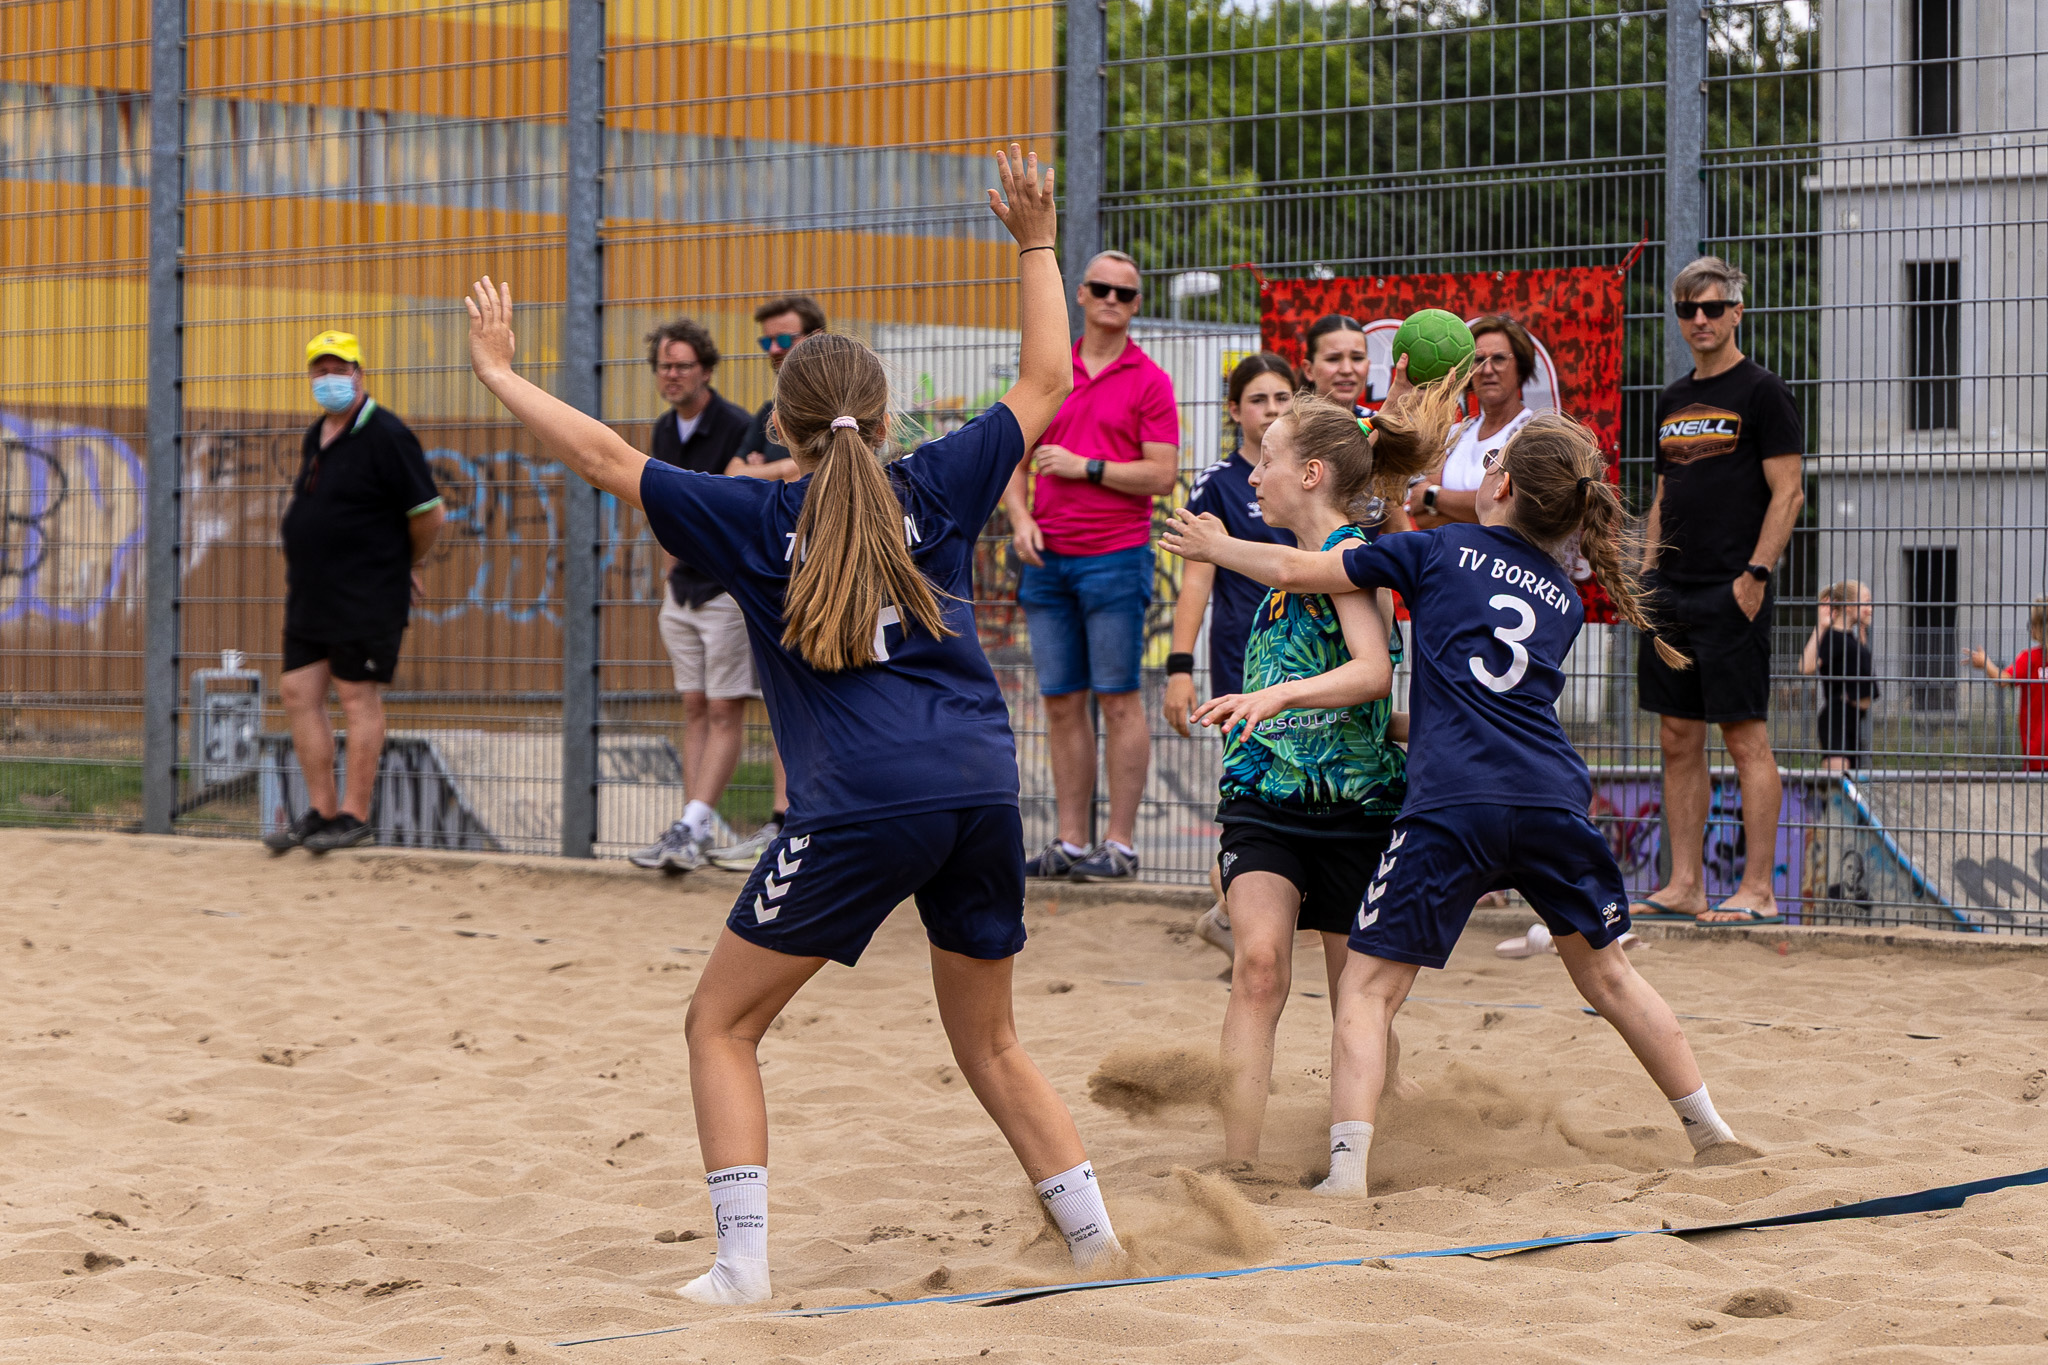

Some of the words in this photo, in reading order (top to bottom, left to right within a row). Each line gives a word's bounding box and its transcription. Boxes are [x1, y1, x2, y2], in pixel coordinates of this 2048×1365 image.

[1458, 546, 1487, 571] TV
[1491, 558, 1570, 615] BORKEN
[1468, 594, 1536, 693] 3
[734, 1213, 764, 1221] Borken
